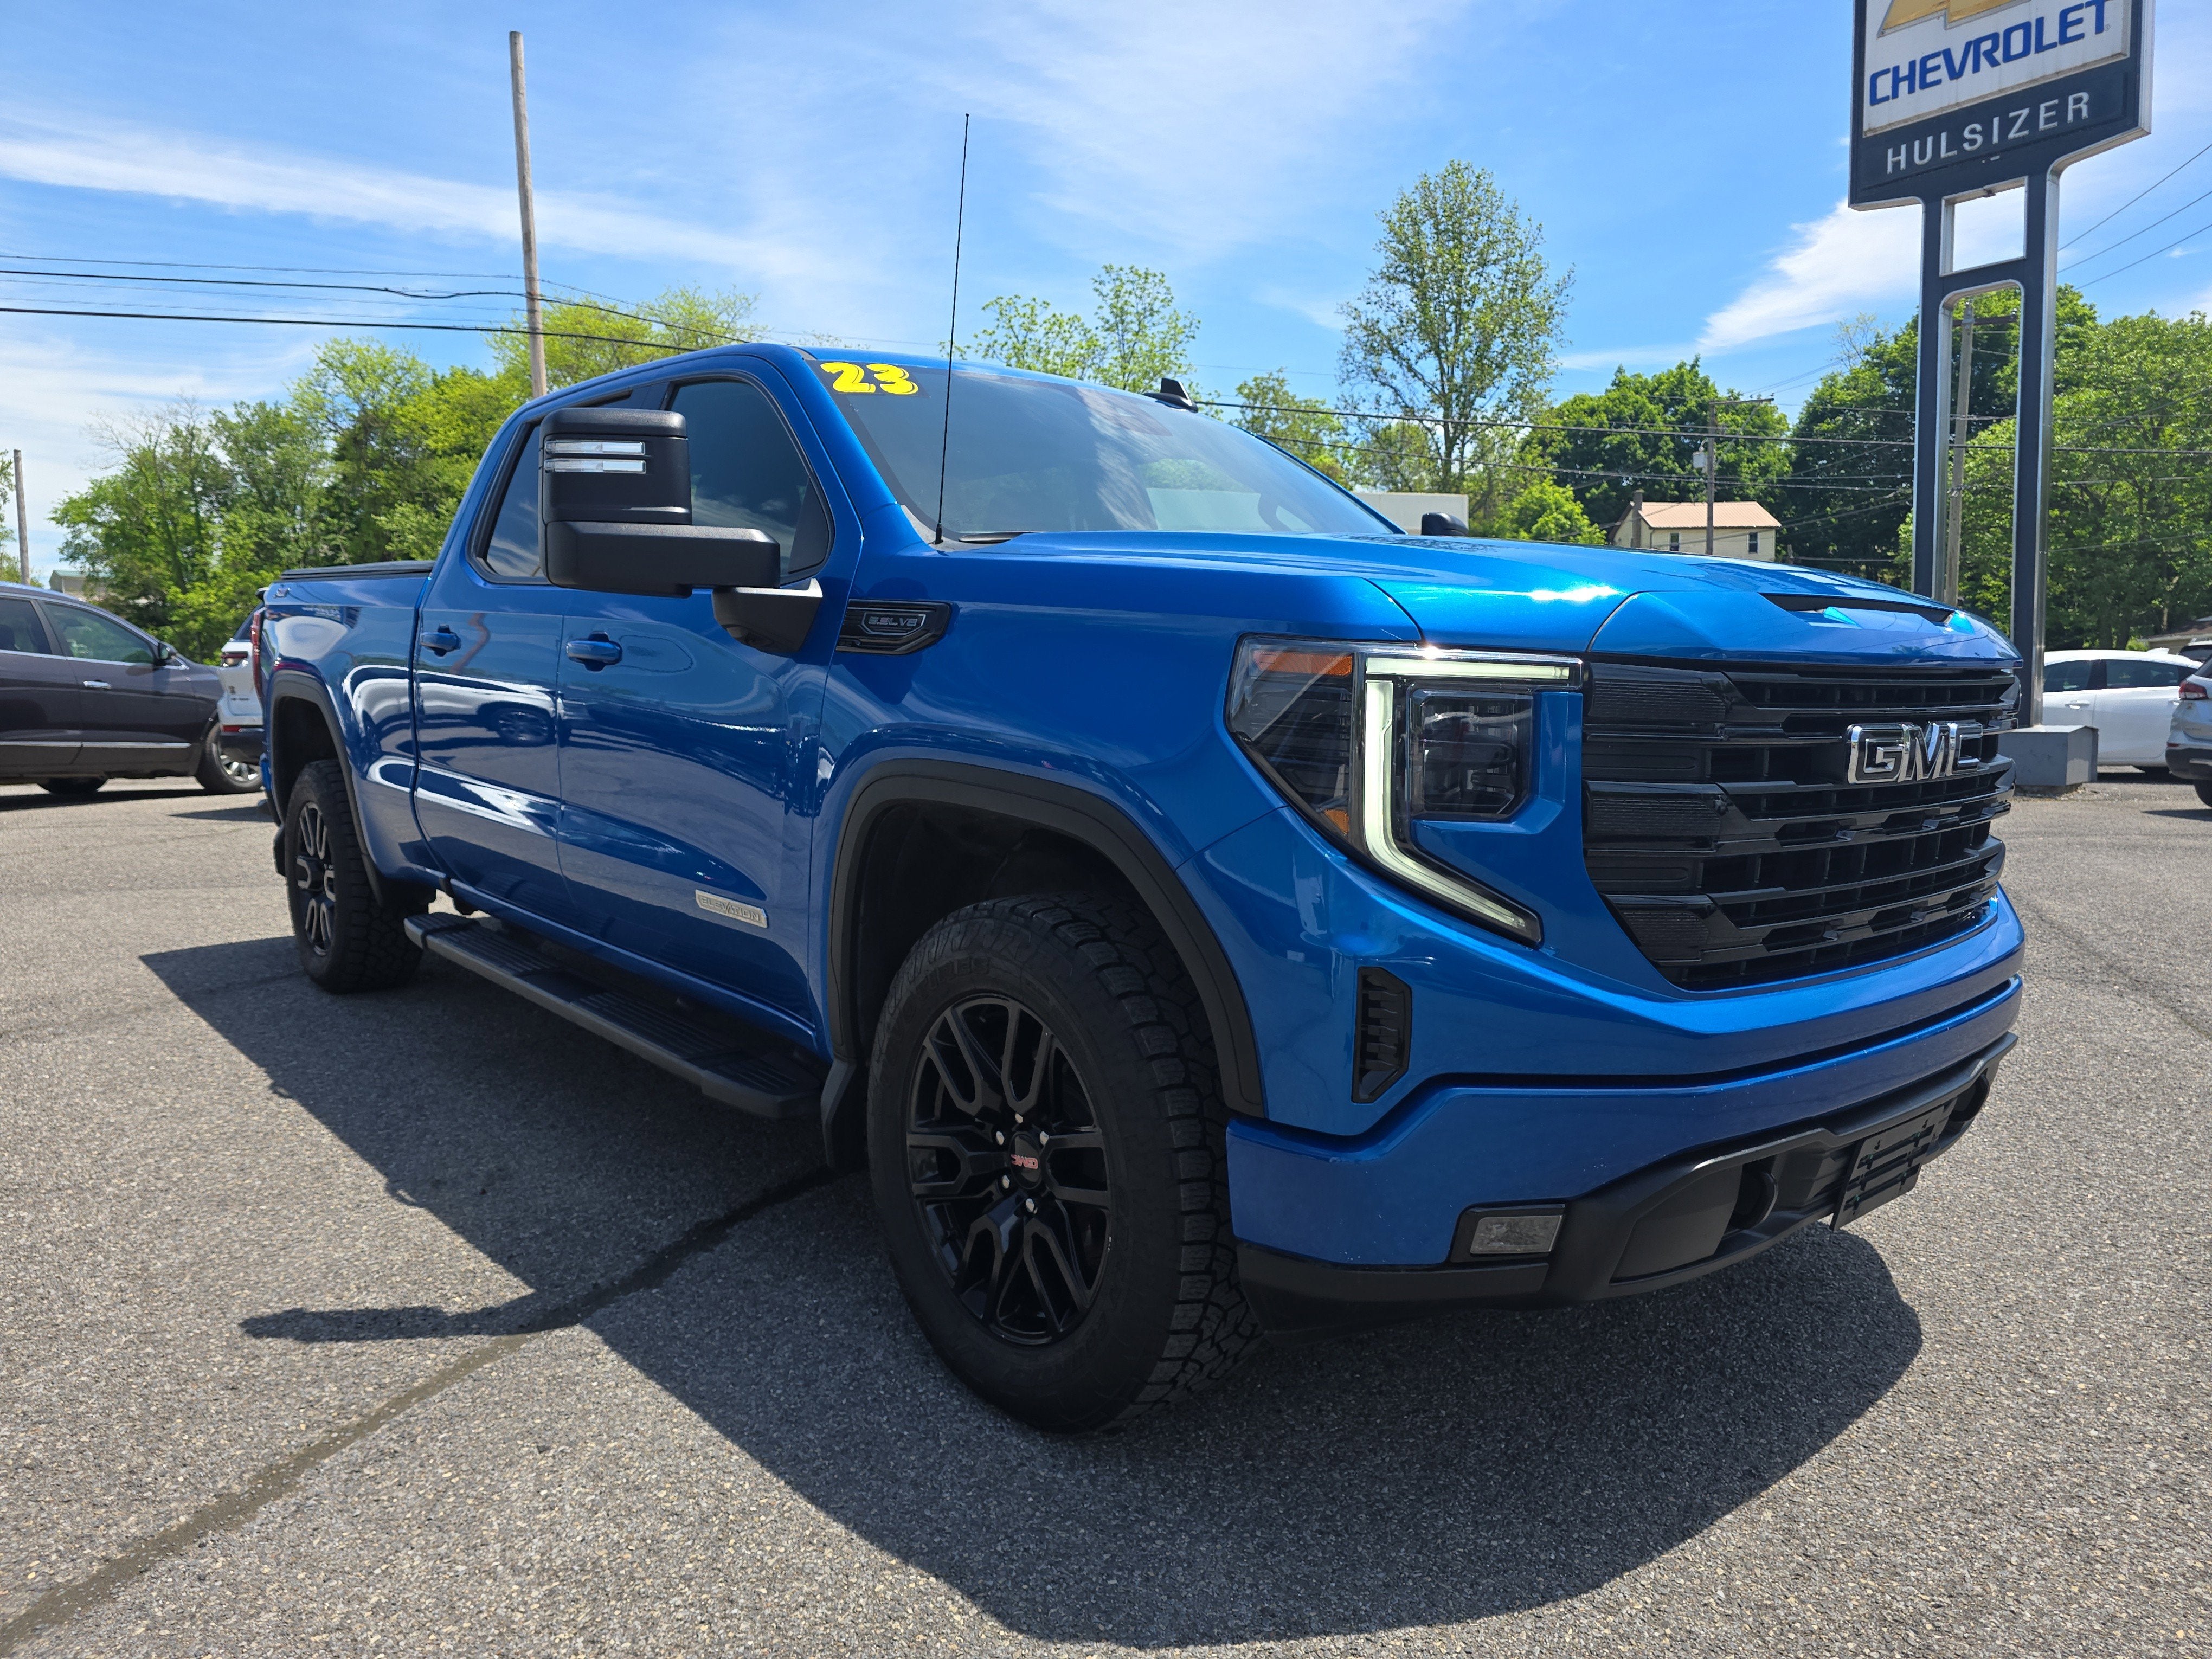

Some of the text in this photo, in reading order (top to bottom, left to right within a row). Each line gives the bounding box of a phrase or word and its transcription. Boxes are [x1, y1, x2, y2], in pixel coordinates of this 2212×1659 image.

[1869, 0, 2110, 106] CHEVROLET
[1887, 92, 2089, 175] HULSIZER
[820, 362, 918, 395] 23
[1846, 722, 1983, 785] GMC
[700, 897, 760, 921] ELEVATION
[1011, 1154, 1038, 1169] GMC
